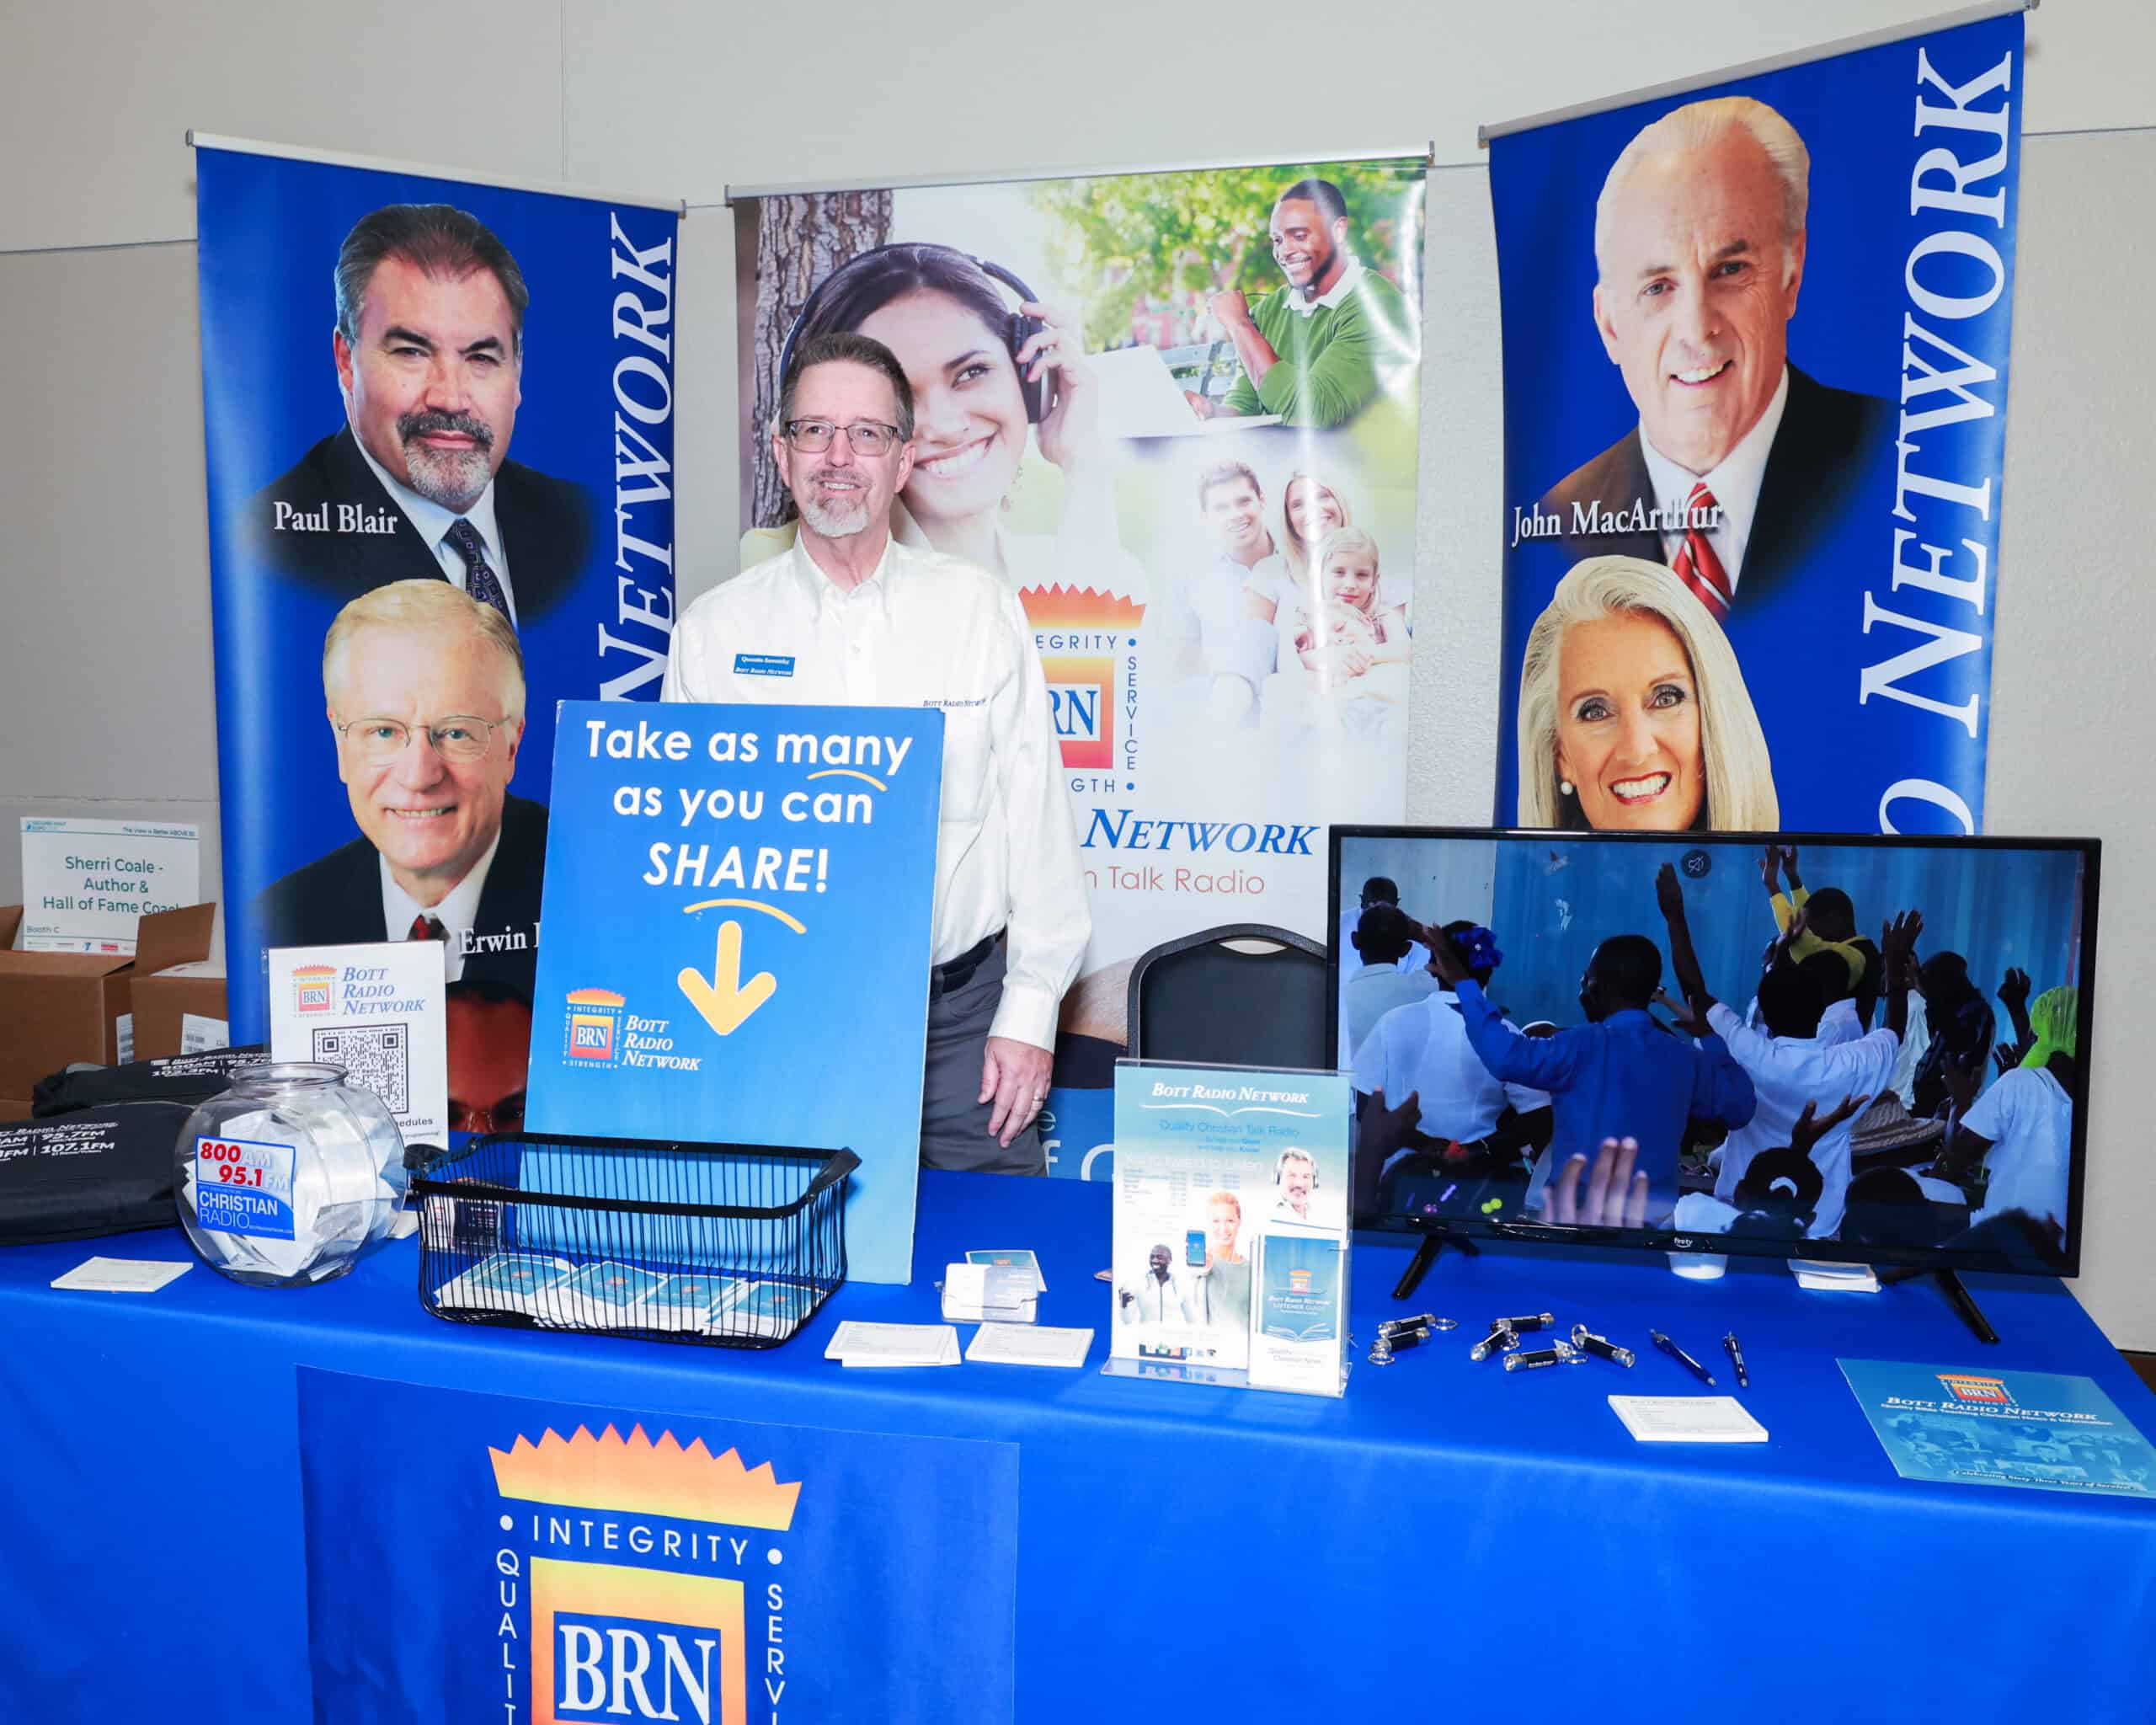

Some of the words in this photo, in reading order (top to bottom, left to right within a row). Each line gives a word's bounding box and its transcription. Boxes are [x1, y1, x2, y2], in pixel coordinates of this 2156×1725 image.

[1860, 47, 2012, 738] NETWORK
[273, 501, 330, 532] Paul
[336, 504, 398, 535] Blair
[1512, 502, 1562, 547] John
[1570, 497, 1723, 535] MacArthur
[1036, 635, 1117, 649] EGRITY
[1049, 689, 1097, 736] RN
[1125, 656, 1138, 770] SERVICE
[586, 719, 691, 761] Take
[708, 730, 759, 762] as
[776, 733, 913, 776] many
[613, 785, 663, 817] as
[679, 788, 764, 826] you
[782, 792, 873, 824] can
[1080, 808, 1321, 856] NETWORK
[65, 856, 110, 871] Sherri
[115, 857, 155, 873] Coale
[643, 841, 830, 893] SHARE!
[83, 878, 135, 893] Author
[140, 881, 149, 894] &
[1107, 865, 1164, 891] Talk
[1175, 868, 1265, 895] Radio
[43, 896, 74, 911] Hall
[78, 897, 93, 911] of
[98, 898, 139, 914] Fame
[458, 926, 528, 955] Erwin
[343, 967, 389, 982] BOTT
[303, 990, 325, 1004] BRN
[342, 984, 395, 999] RADIO
[342, 998, 426, 1016] NETWORK
[625, 1015, 669, 1033] BOTT
[576, 1027, 607, 1047] BRN
[623, 1033, 673, 1051] RADIO
[622, 1050, 702, 1071] NETWORK
[1152, 1081, 1190, 1097] BOTT
[1193, 1084, 1235, 1100] RADIO
[1239, 1087, 1310, 1103] NETWORK
[41, 1130, 106, 1140] 95.7FM
[40, 1141, 115, 1155] 107.1FM
[200, 1141, 242, 1162] 800
[219, 1164, 263, 1187] 95.1
[199, 1190, 279, 1216] CHRISTIAN
[200, 1207, 250, 1229] RADIO
[1961, 1387, 1998, 1398] BRN
[1886, 1397, 1936, 1407] BOTT
[1941, 1402, 1999, 1413] RADIO
[2004, 1407, 2099, 1420] NETWORK
[532, 1515, 749, 1566] INTEGRITY
[496, 1548, 520, 1725] QUALIT
[764, 1583, 786, 1725] SERVI
[558, 1624, 717, 1725] BRN
